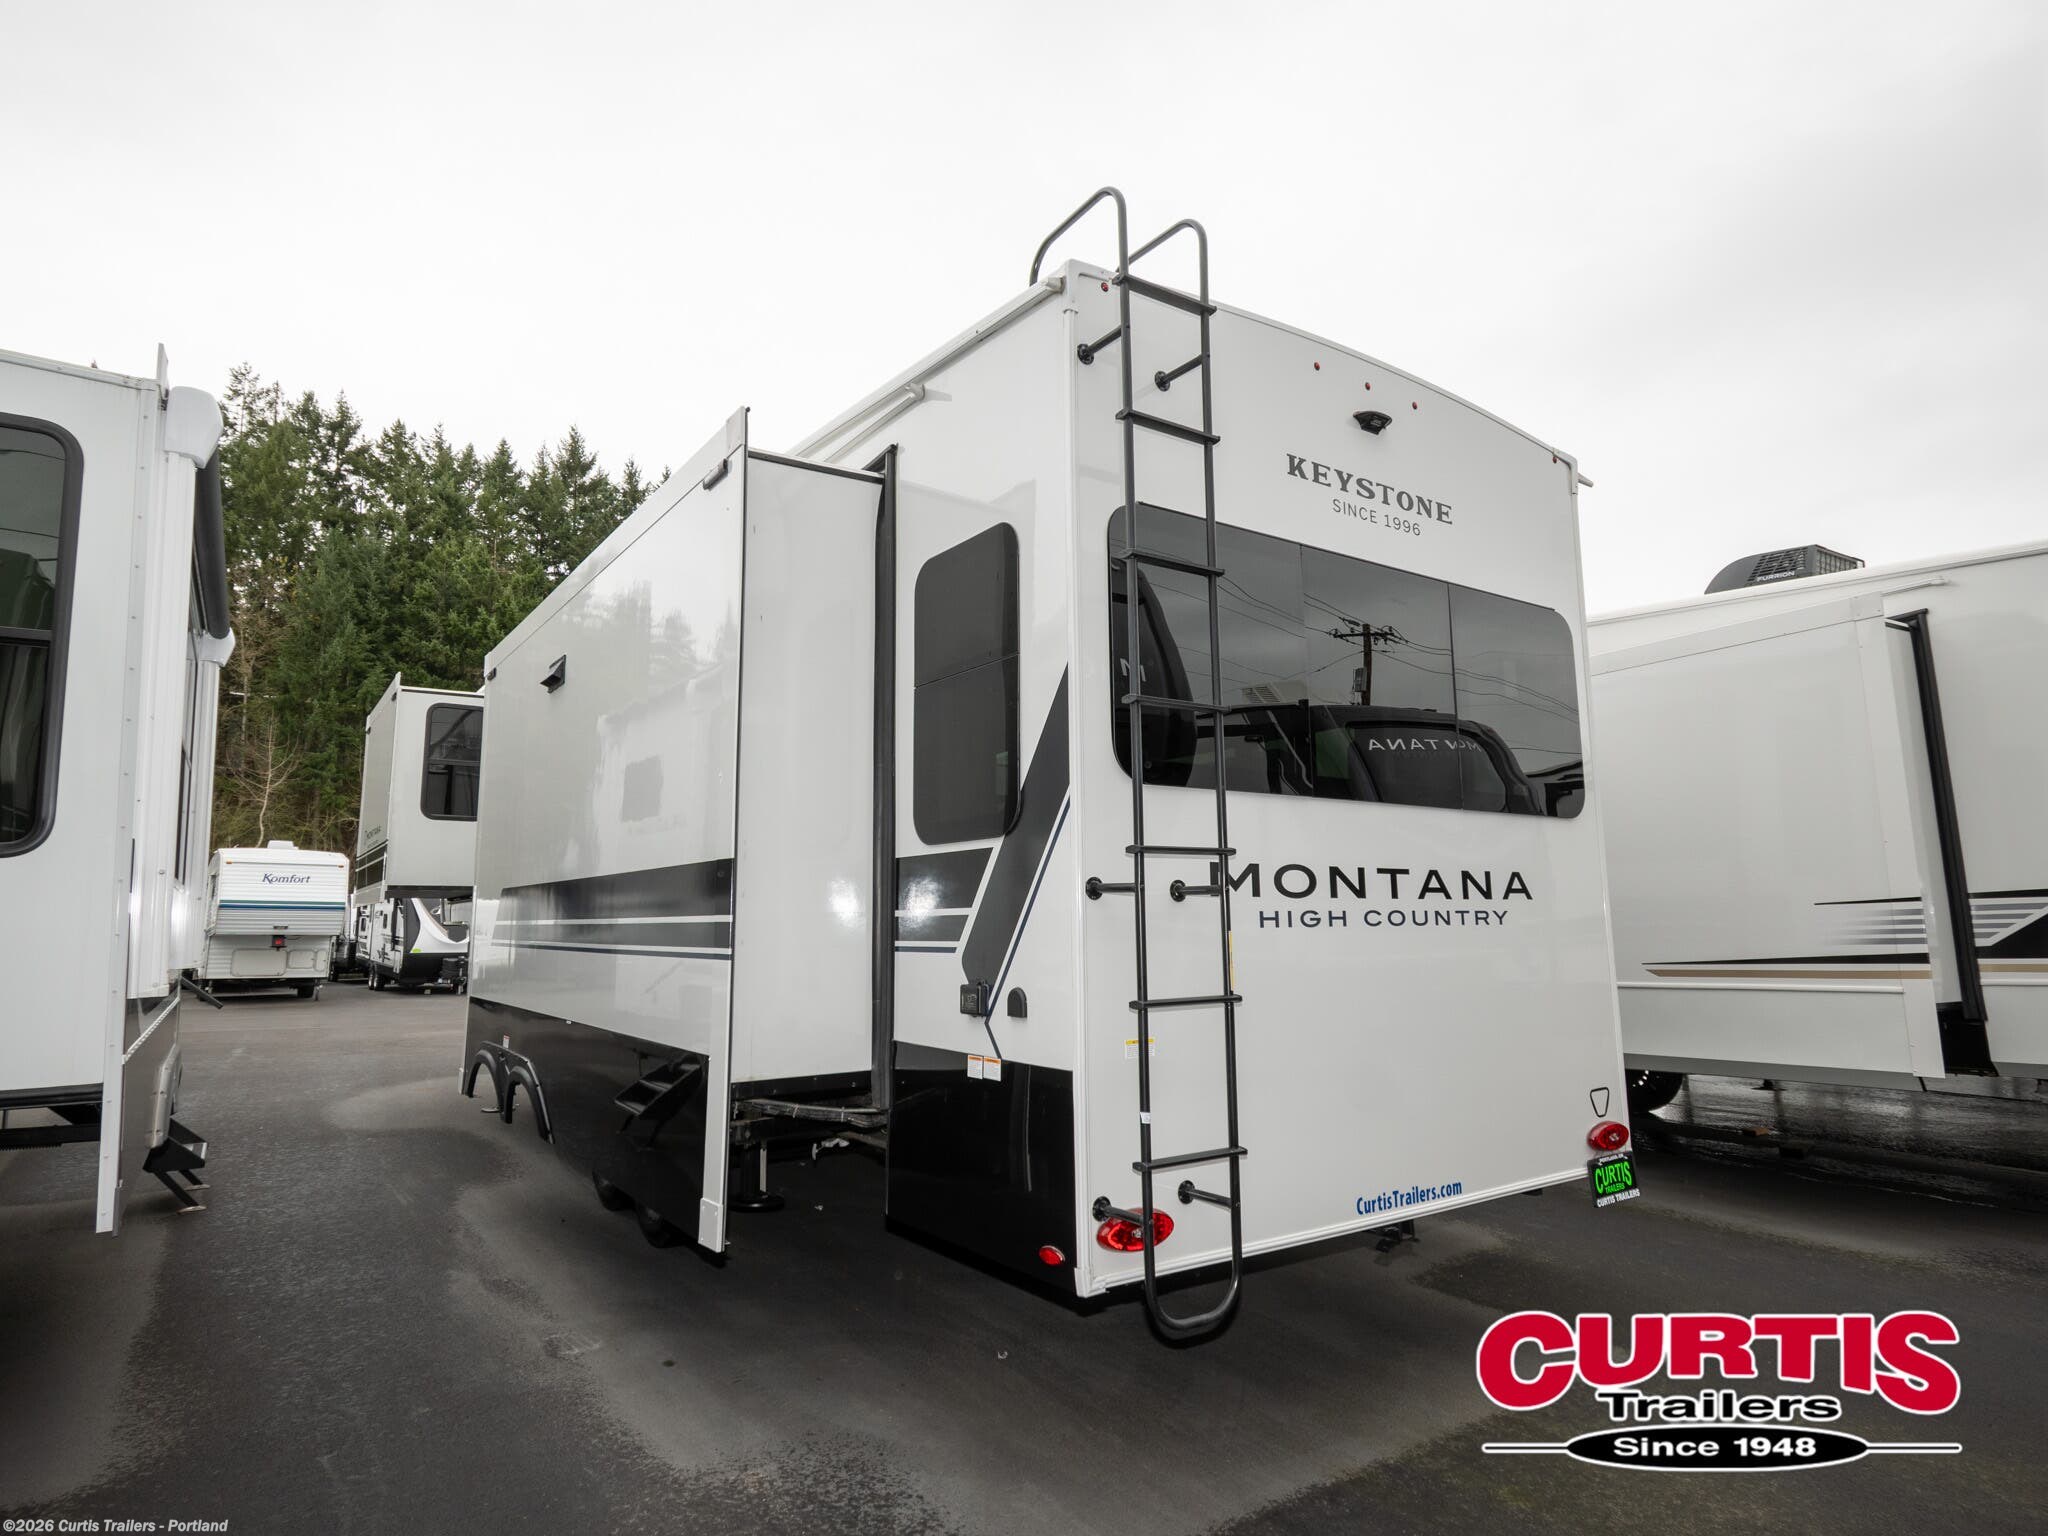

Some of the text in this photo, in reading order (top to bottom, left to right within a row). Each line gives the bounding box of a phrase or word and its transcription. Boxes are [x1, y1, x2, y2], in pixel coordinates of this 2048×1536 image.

[1286, 453, 1453, 525] KEYSTONE
[1332, 498, 1421, 536] SINCE 1996
[1757, 571, 1795, 581] FURRION
[262, 873, 310, 884] Komfort
[1209, 861, 1533, 901] MONTANA
[1259, 909, 1509, 929] HIGH COUNTRY
[1595, 1161, 1632, 1194] CURTIS
[1356, 1181, 1463, 1215] CurtisTrailers.com
[1597, 1188, 1640, 1207] CURTIS TRAILERS
